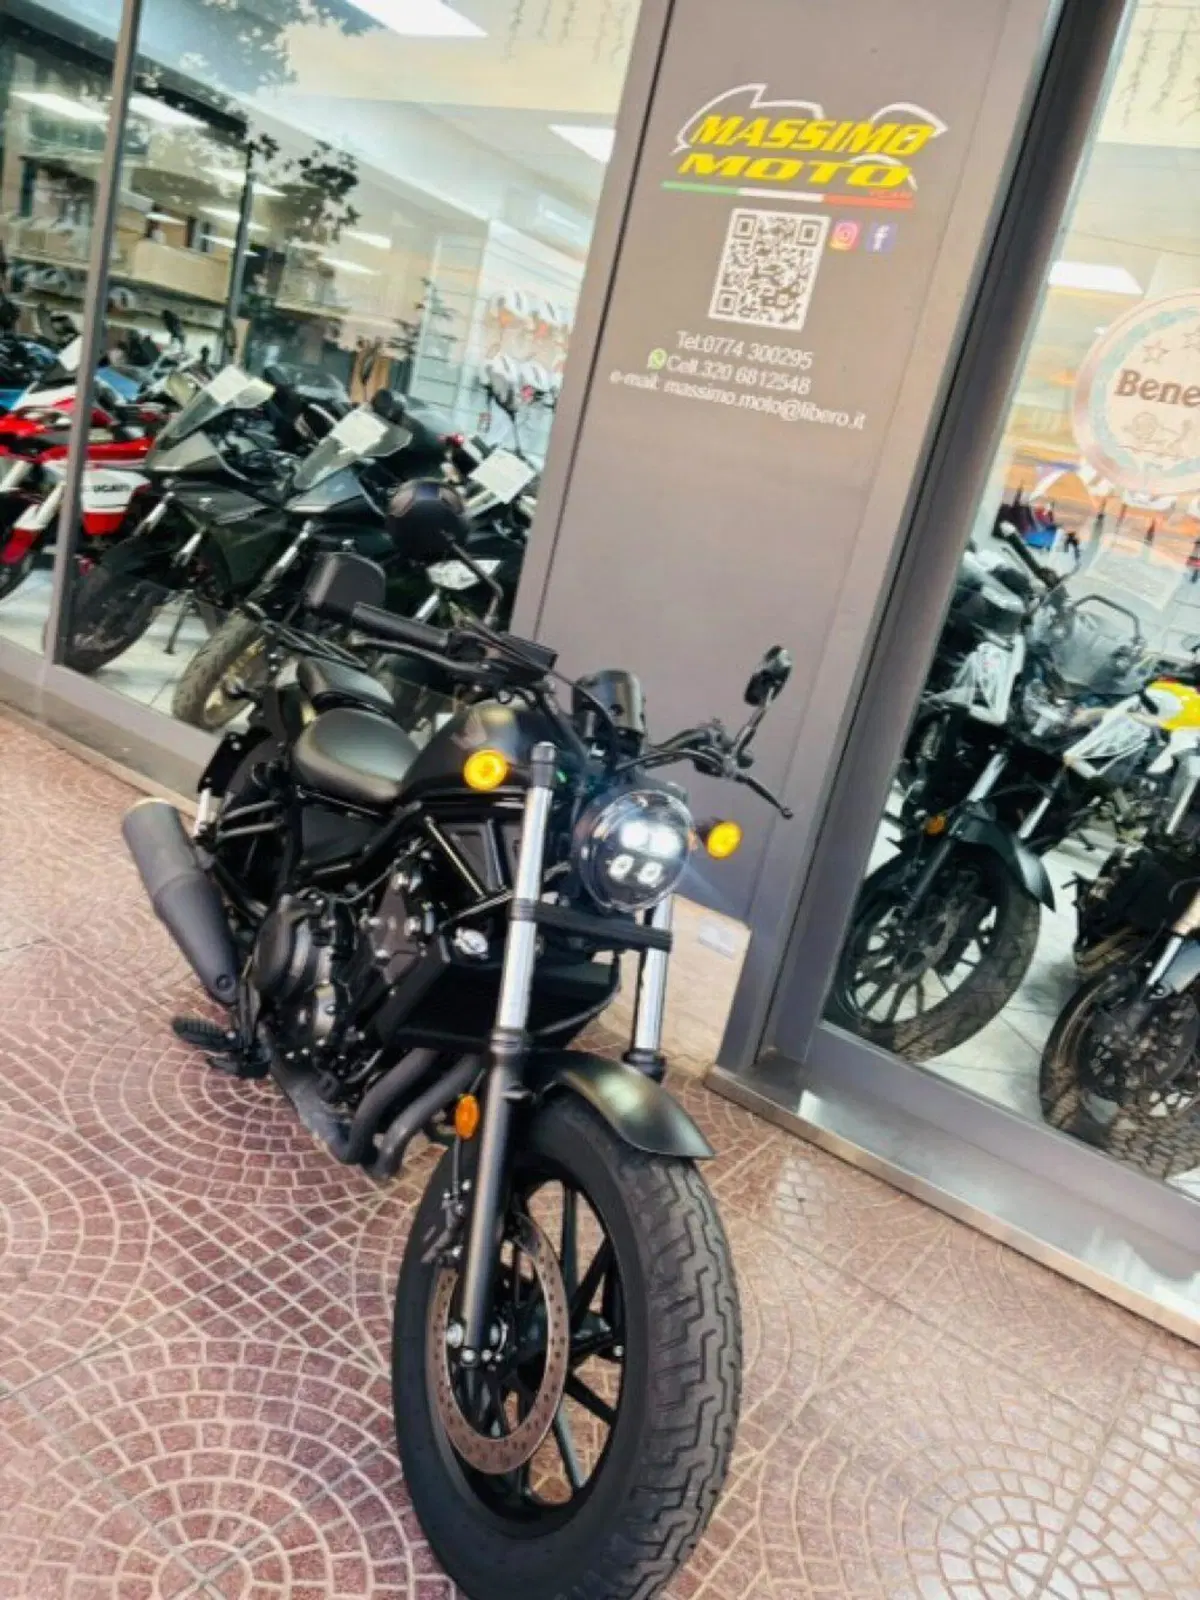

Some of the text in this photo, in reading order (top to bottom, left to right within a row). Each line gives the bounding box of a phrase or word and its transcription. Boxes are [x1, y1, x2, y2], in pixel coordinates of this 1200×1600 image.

[690, 115, 935, 157] MASSIMO
[678, 152, 910, 188] MOTO
[747, 342, 814, 371] 300295
